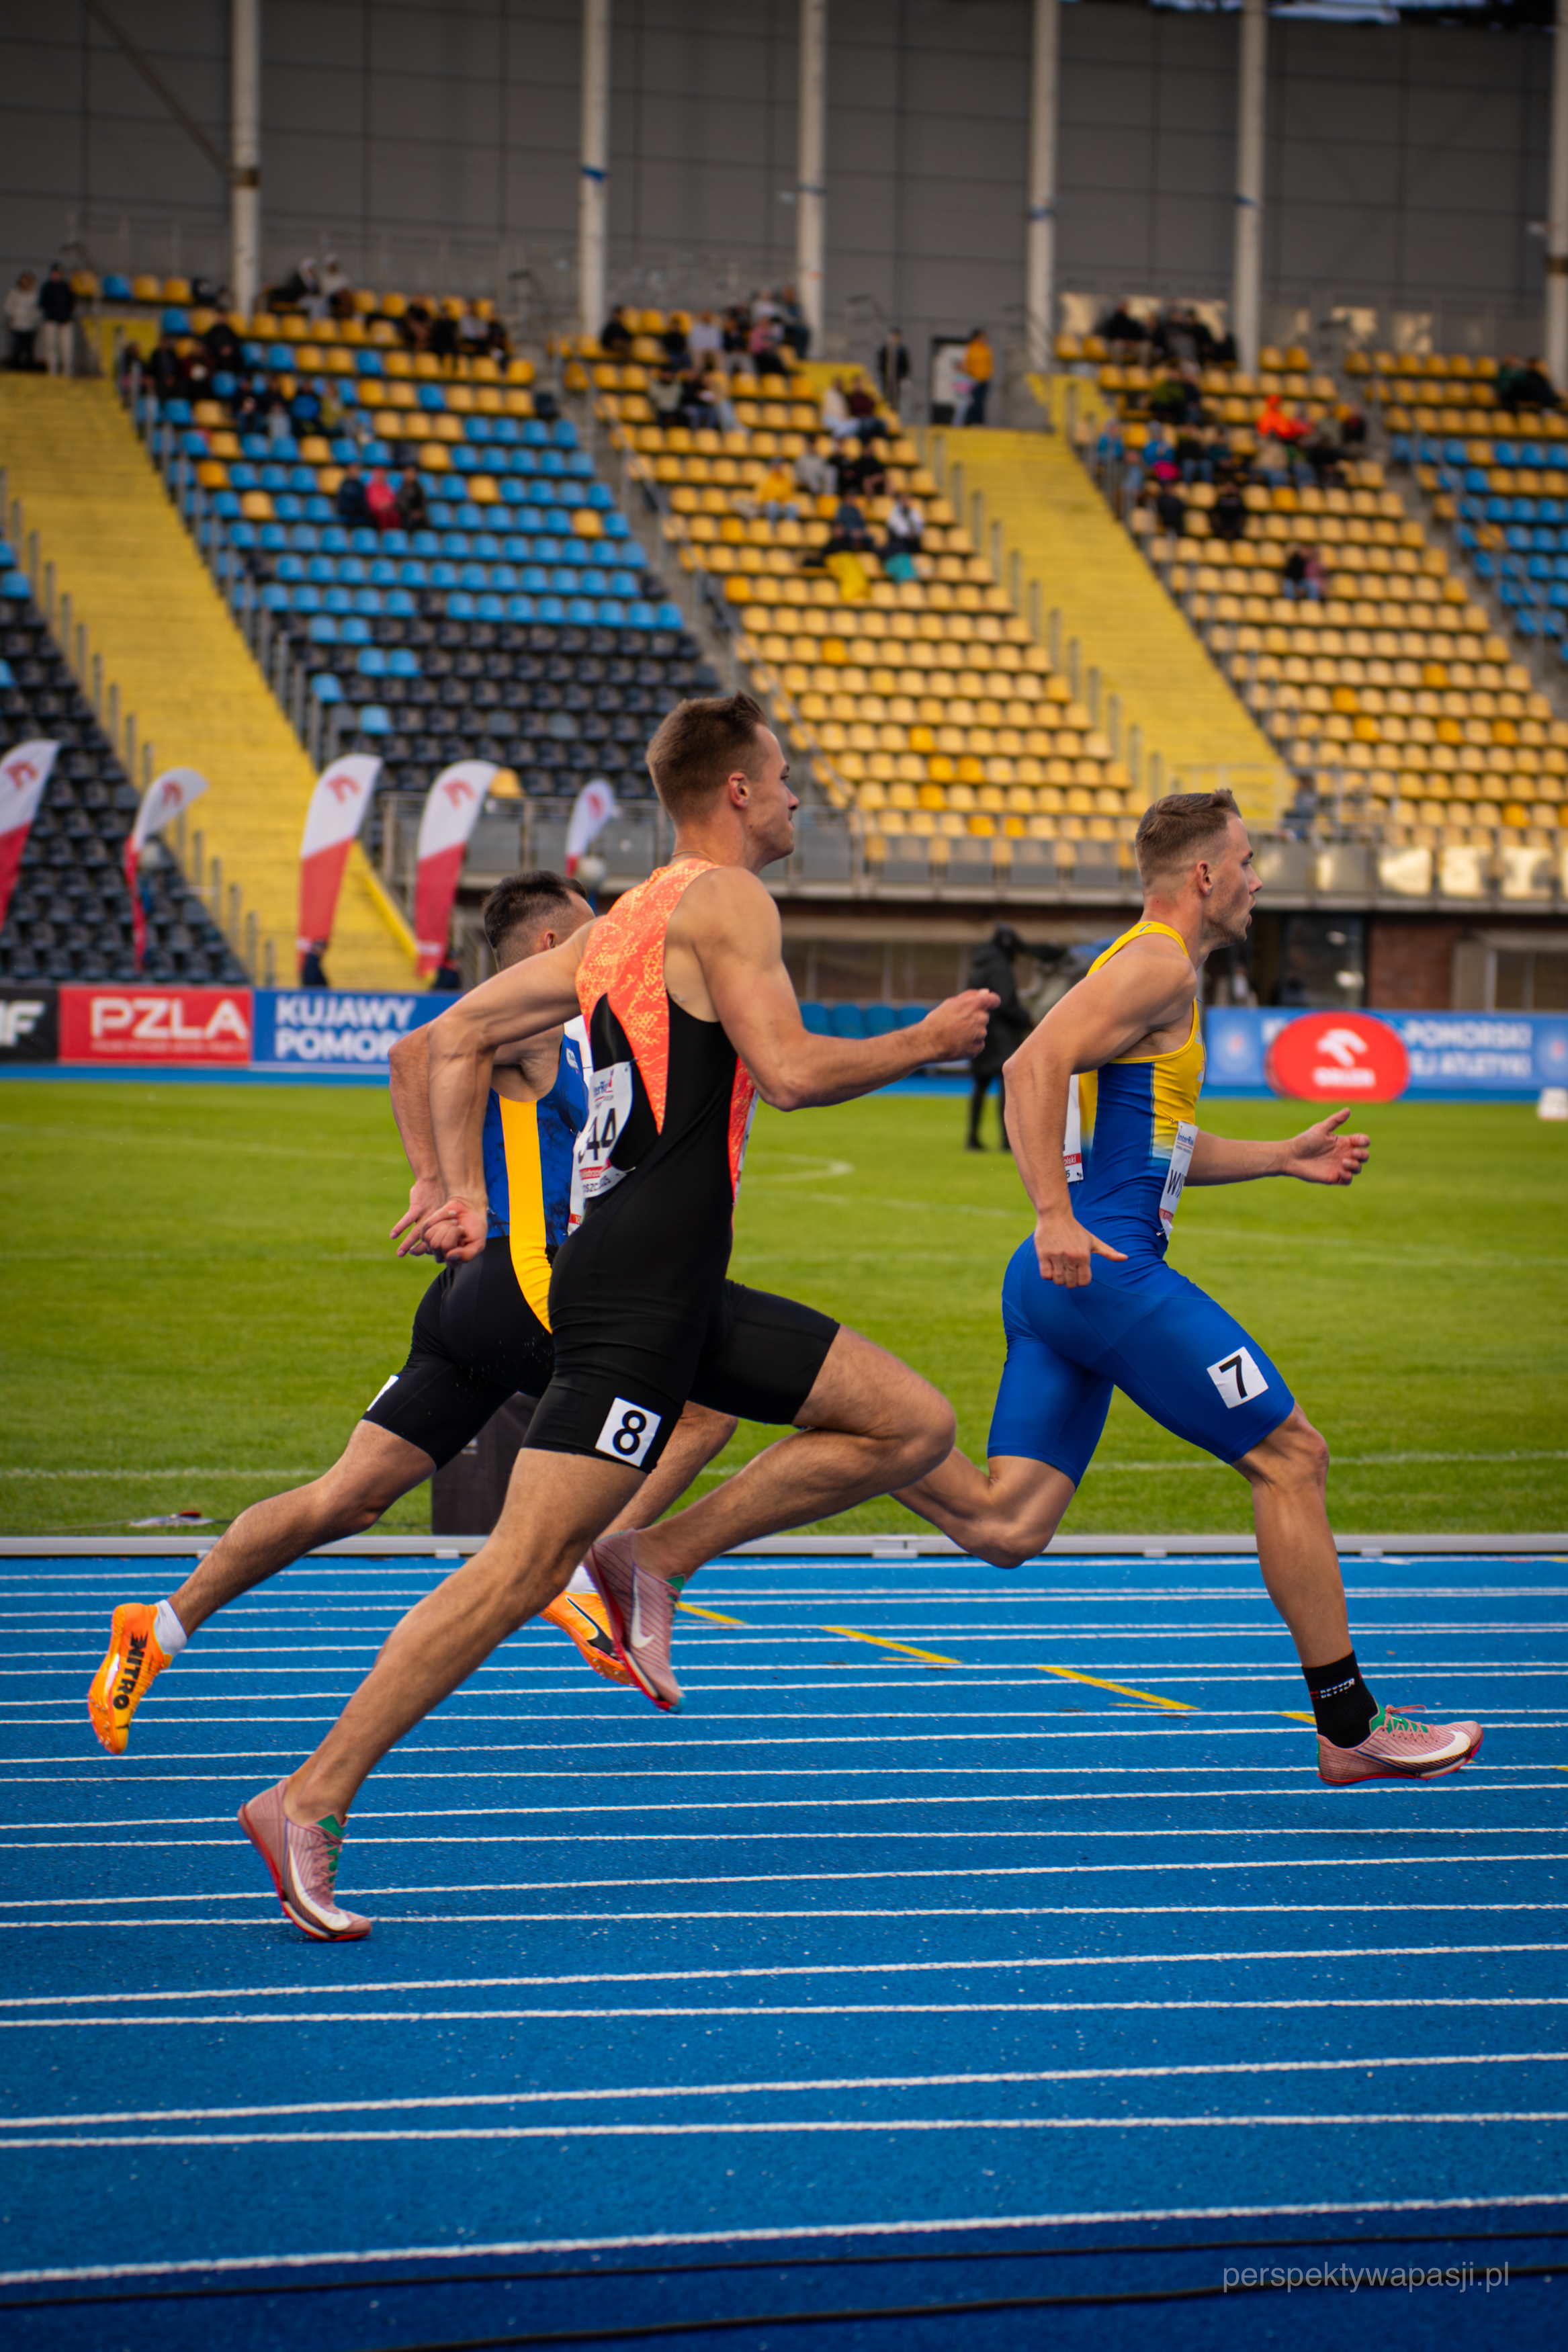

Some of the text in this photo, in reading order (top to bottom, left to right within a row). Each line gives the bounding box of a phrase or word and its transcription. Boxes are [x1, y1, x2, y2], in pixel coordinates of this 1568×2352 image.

[91, 997, 249, 1041] PZLA
[275, 994, 416, 1029] KUJAWY
[1218, 1354, 1248, 1399] 7
[612, 1409, 648, 1456] 8
